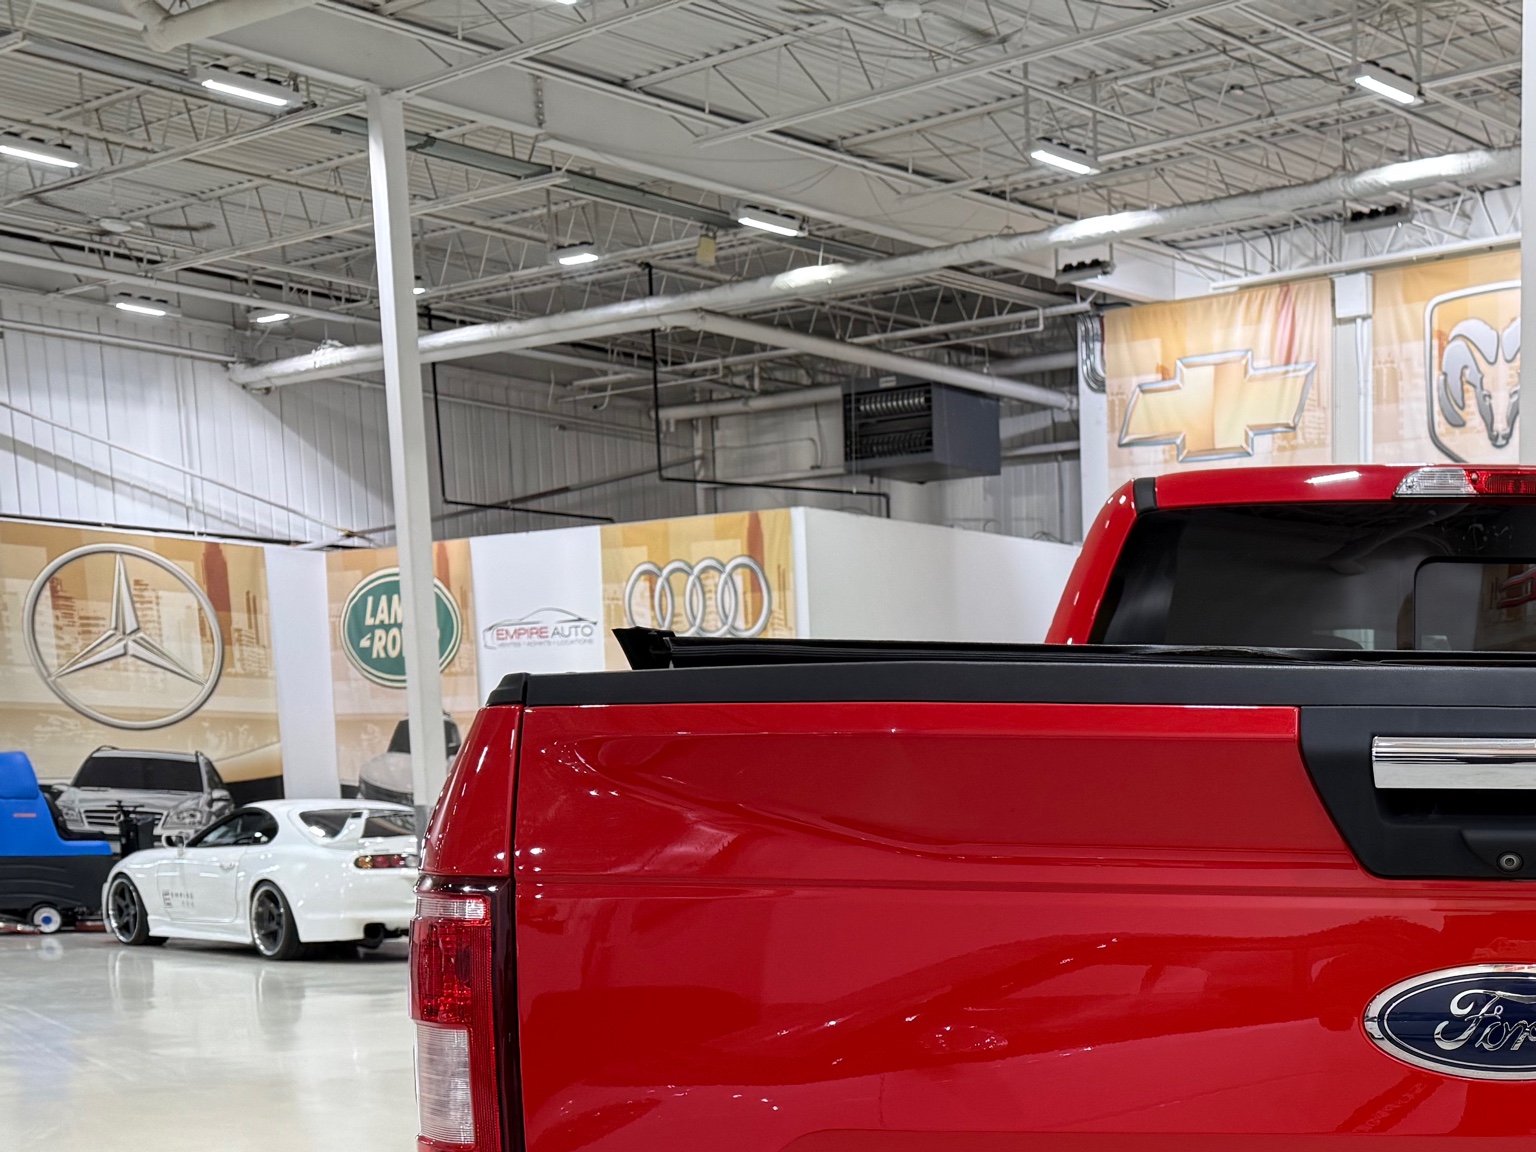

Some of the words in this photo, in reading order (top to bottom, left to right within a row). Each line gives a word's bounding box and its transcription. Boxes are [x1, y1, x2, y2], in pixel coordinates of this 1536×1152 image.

[365, 593, 403, 626] LAN
[496, 626, 549, 641] EMPIRE
[551, 624, 594, 639] AUTO
